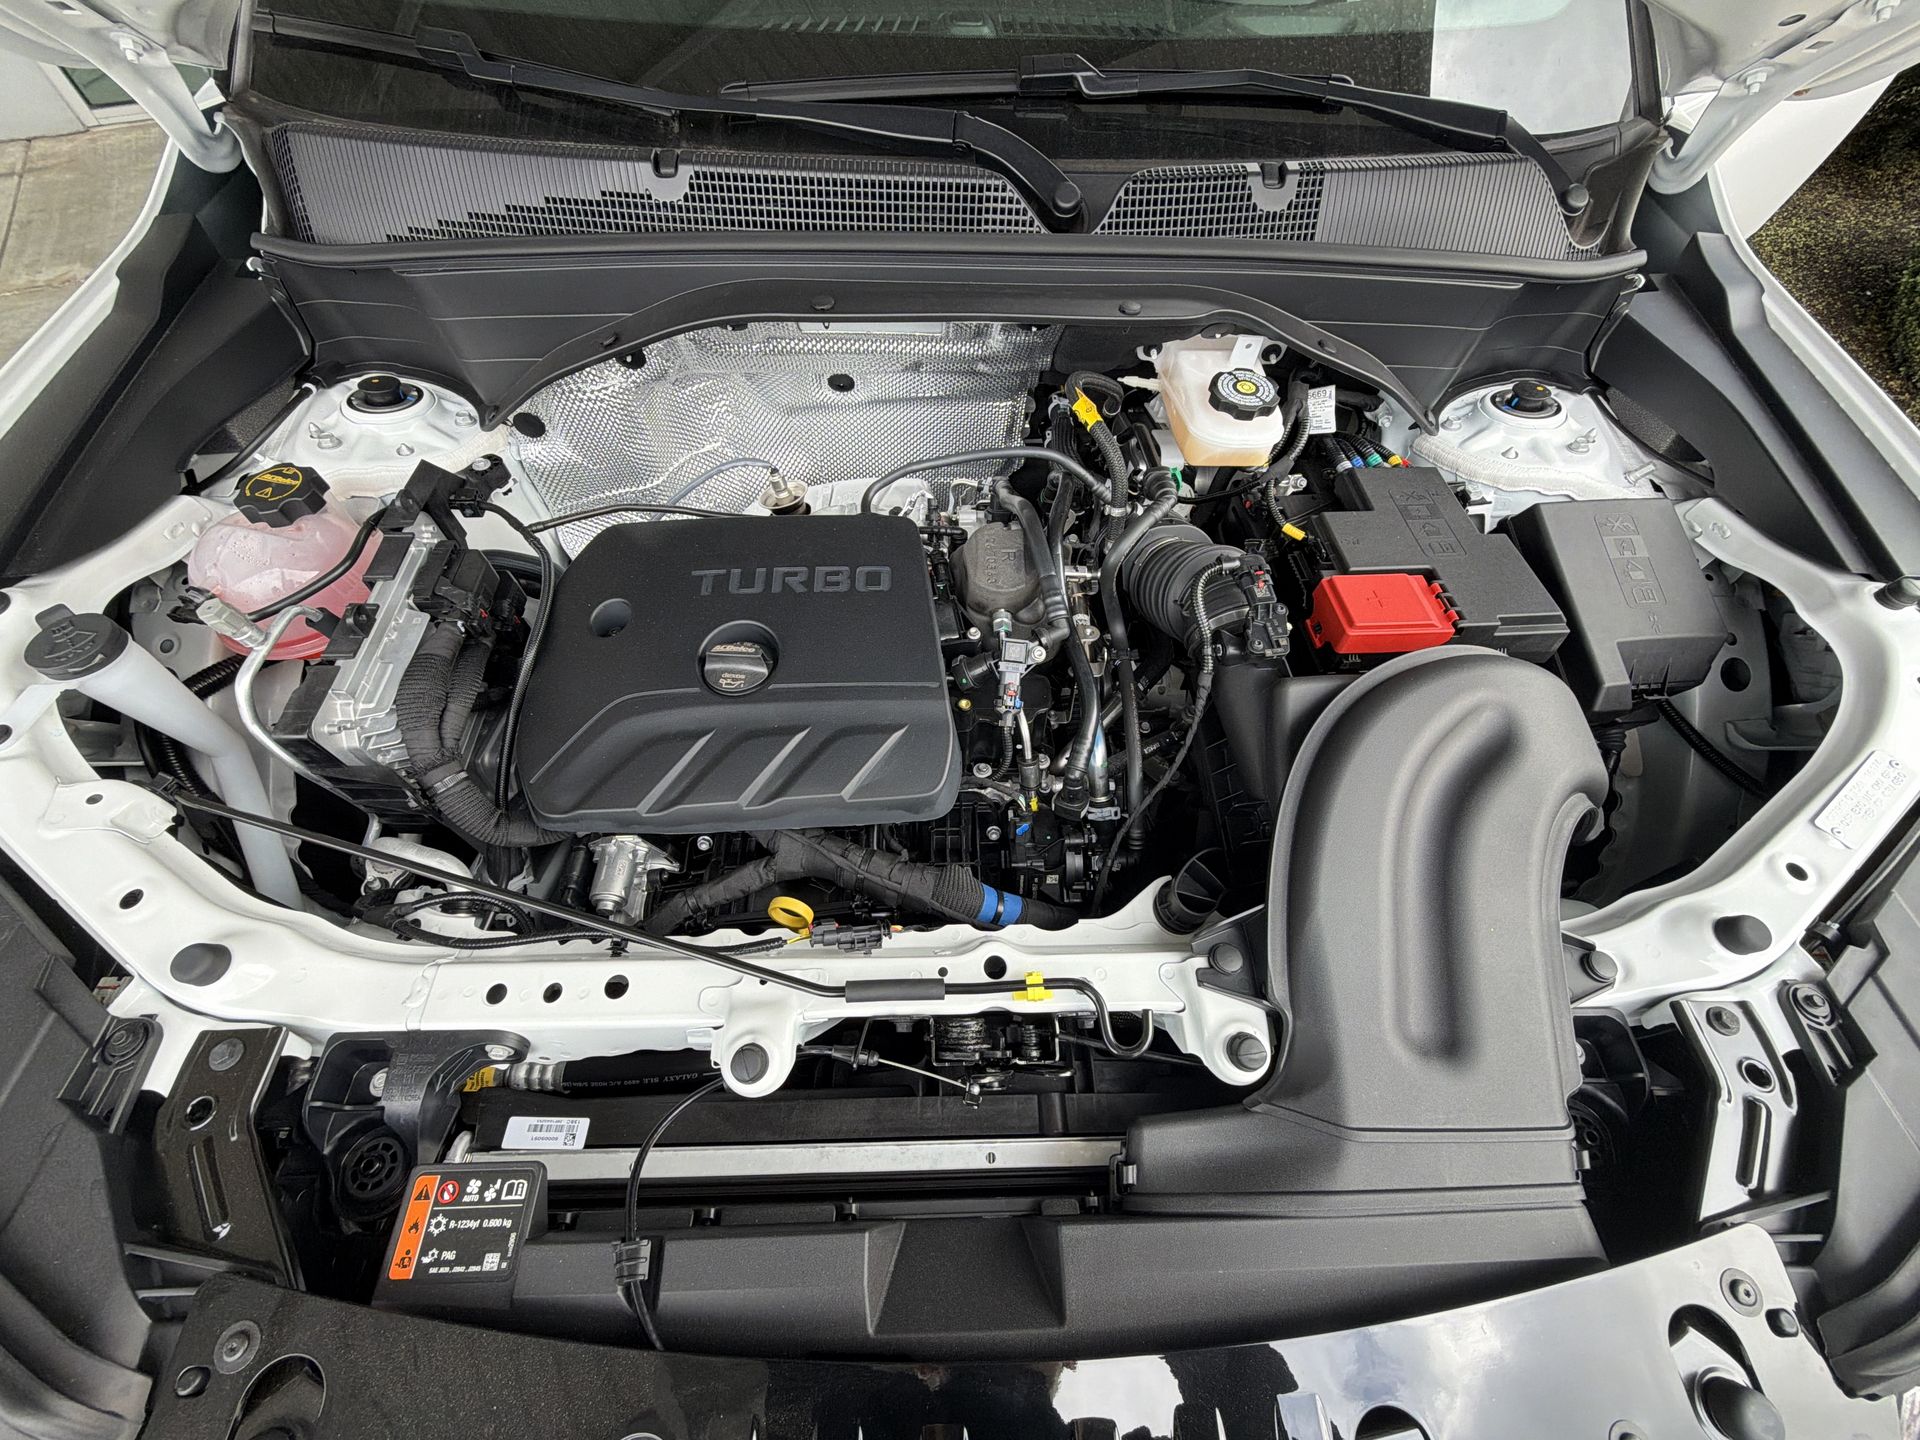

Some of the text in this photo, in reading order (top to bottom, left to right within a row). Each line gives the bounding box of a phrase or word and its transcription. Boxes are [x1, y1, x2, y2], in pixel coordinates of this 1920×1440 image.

[690, 565, 892, 596] TURBO
[711, 644, 756, 653] ACDelco
[663, 1072, 698, 1083] GALAXY
[462, 1194, 479, 1202] AUTO
[448, 1219, 481, 1230] R-1234yf
[502, 1218, 512, 1229] kg
[440, 1250, 456, 1261] PAG
